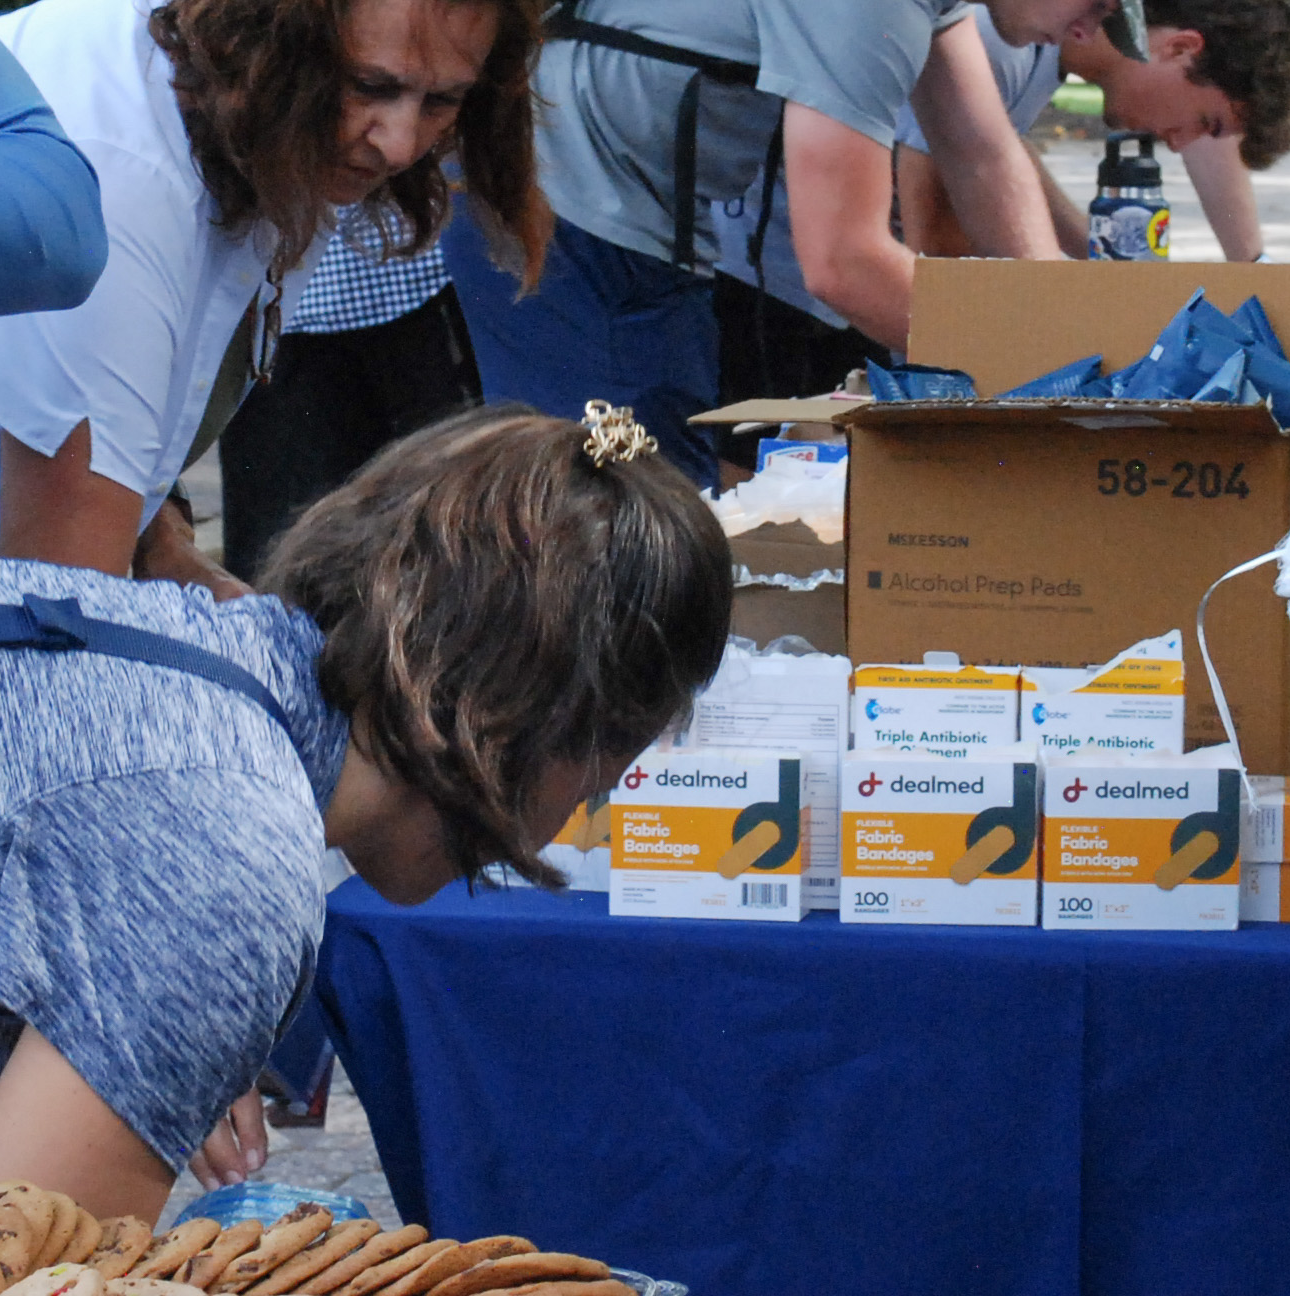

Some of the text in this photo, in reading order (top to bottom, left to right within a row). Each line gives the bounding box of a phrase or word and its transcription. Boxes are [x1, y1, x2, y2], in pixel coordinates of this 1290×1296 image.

[1097, 458, 1250, 500] 58-204
[887, 571, 1083, 599] Alcohol Prep Pads
[874, 729, 989, 745] Triple Antibiotic
[1041, 734, 1082, 750] Triple
[655, 768, 748, 789] dealmed
[890, 775, 985, 794] dealmed
[1095, 780, 1190, 800] dealmed
[623, 822, 671, 837] Fabric
[855, 830, 904, 844] Fabric
[623, 839, 700, 858] Bandages
[1060, 835, 1108, 850] Fabric
[856, 846, 934, 864] Bandages
[1060, 852, 1139, 870] Bandages
[854, 891, 889, 907] 100
[1058, 897, 1094, 913] 100
